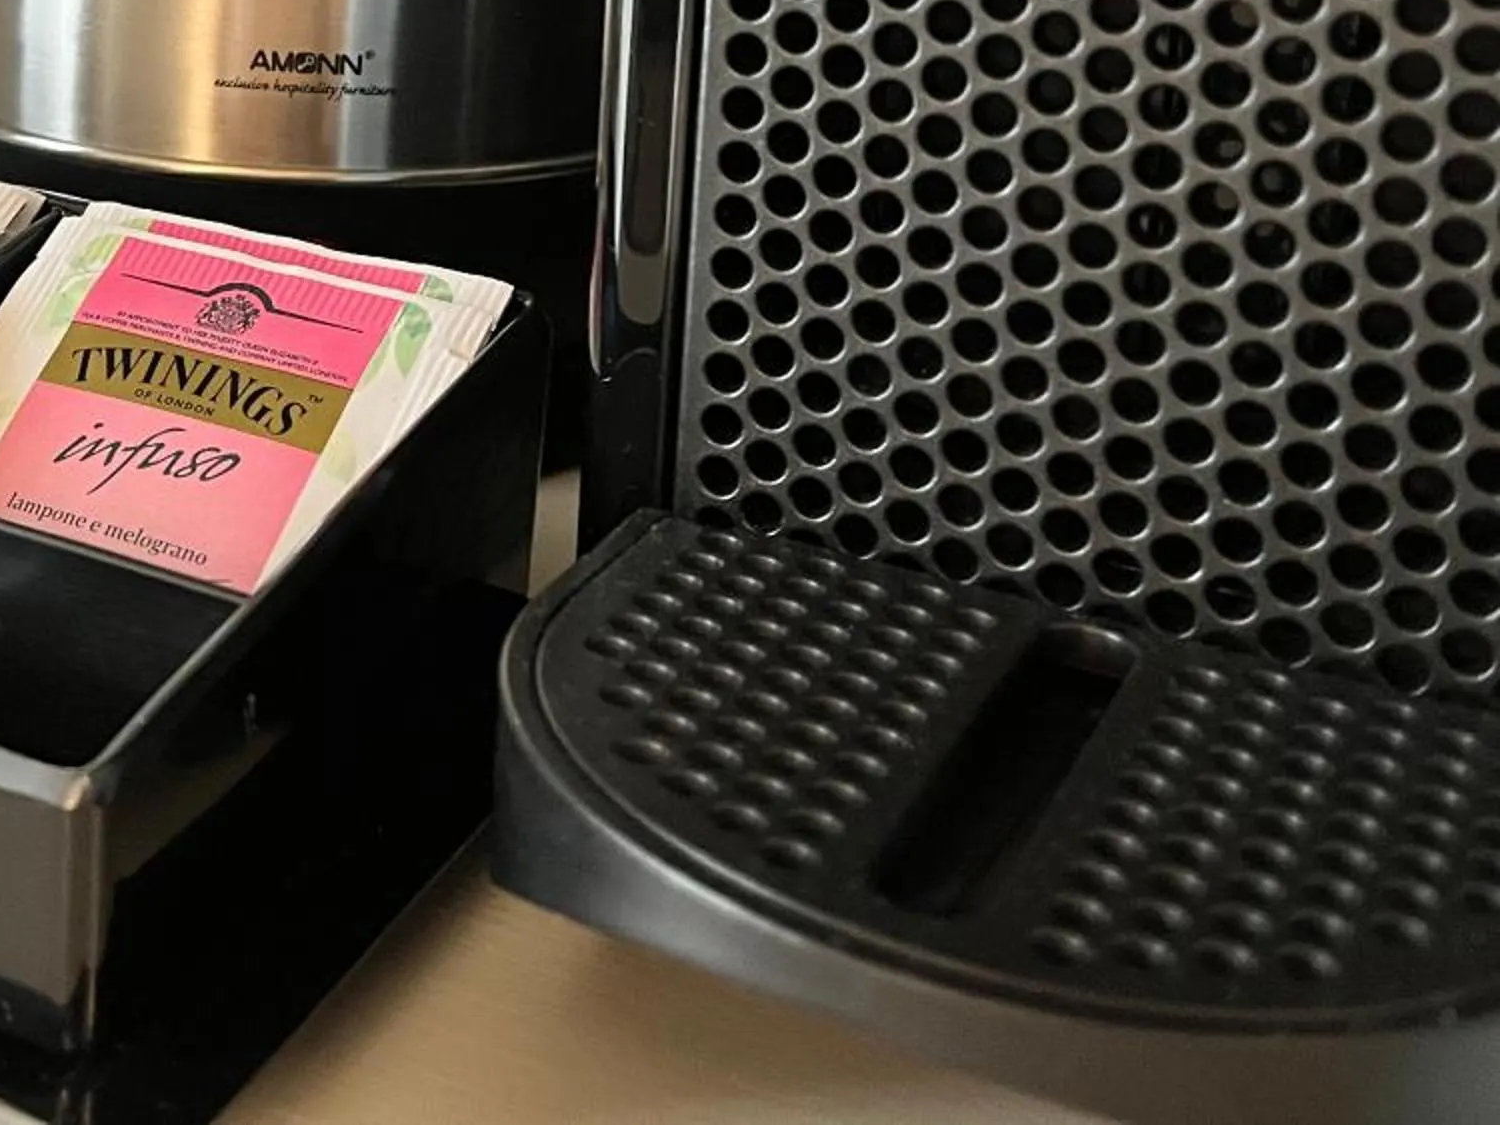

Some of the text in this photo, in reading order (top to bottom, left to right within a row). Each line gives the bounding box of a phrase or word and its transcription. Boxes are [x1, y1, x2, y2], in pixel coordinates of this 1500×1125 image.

[71, 347, 307, 435] TWININGS
[134, 389, 216, 416] OF LONDON
[53, 422, 241, 495] infuso
[7, 492, 209, 566] lampone e melograno
